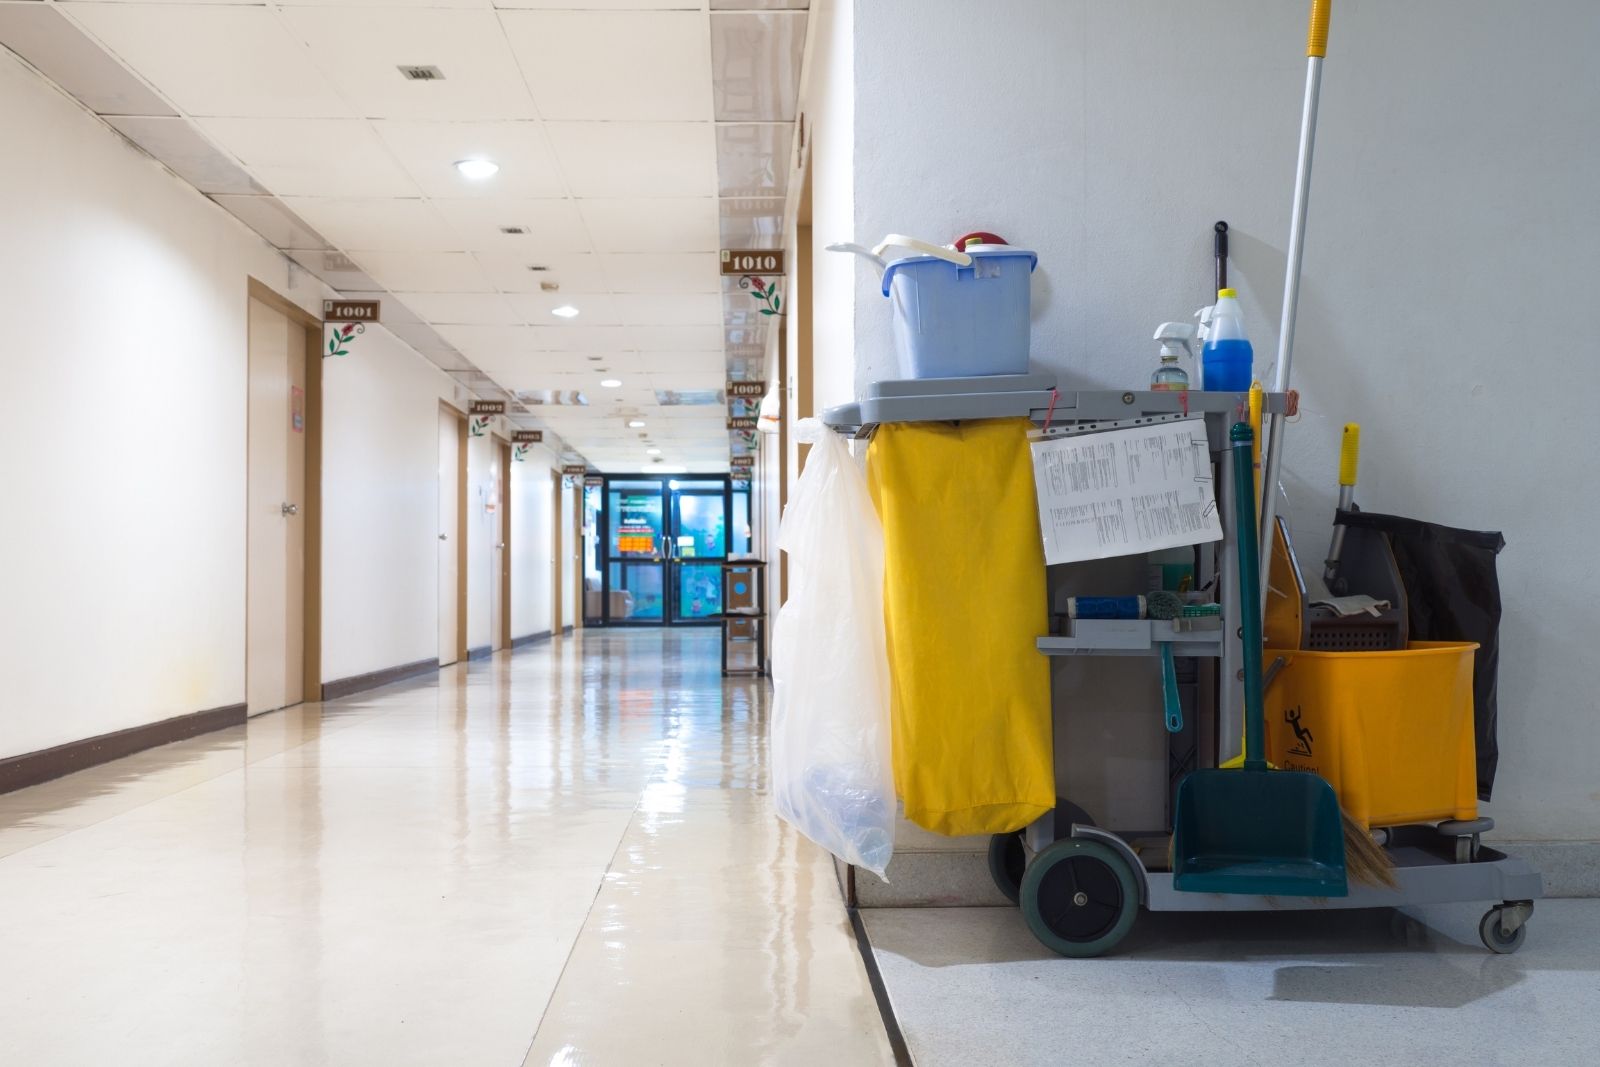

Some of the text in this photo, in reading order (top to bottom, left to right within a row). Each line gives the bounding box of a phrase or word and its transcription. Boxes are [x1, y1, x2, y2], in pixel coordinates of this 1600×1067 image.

[733, 256, 777, 270] 1010
[335, 306, 372, 317] 1001
[733, 385, 762, 394] 1009
